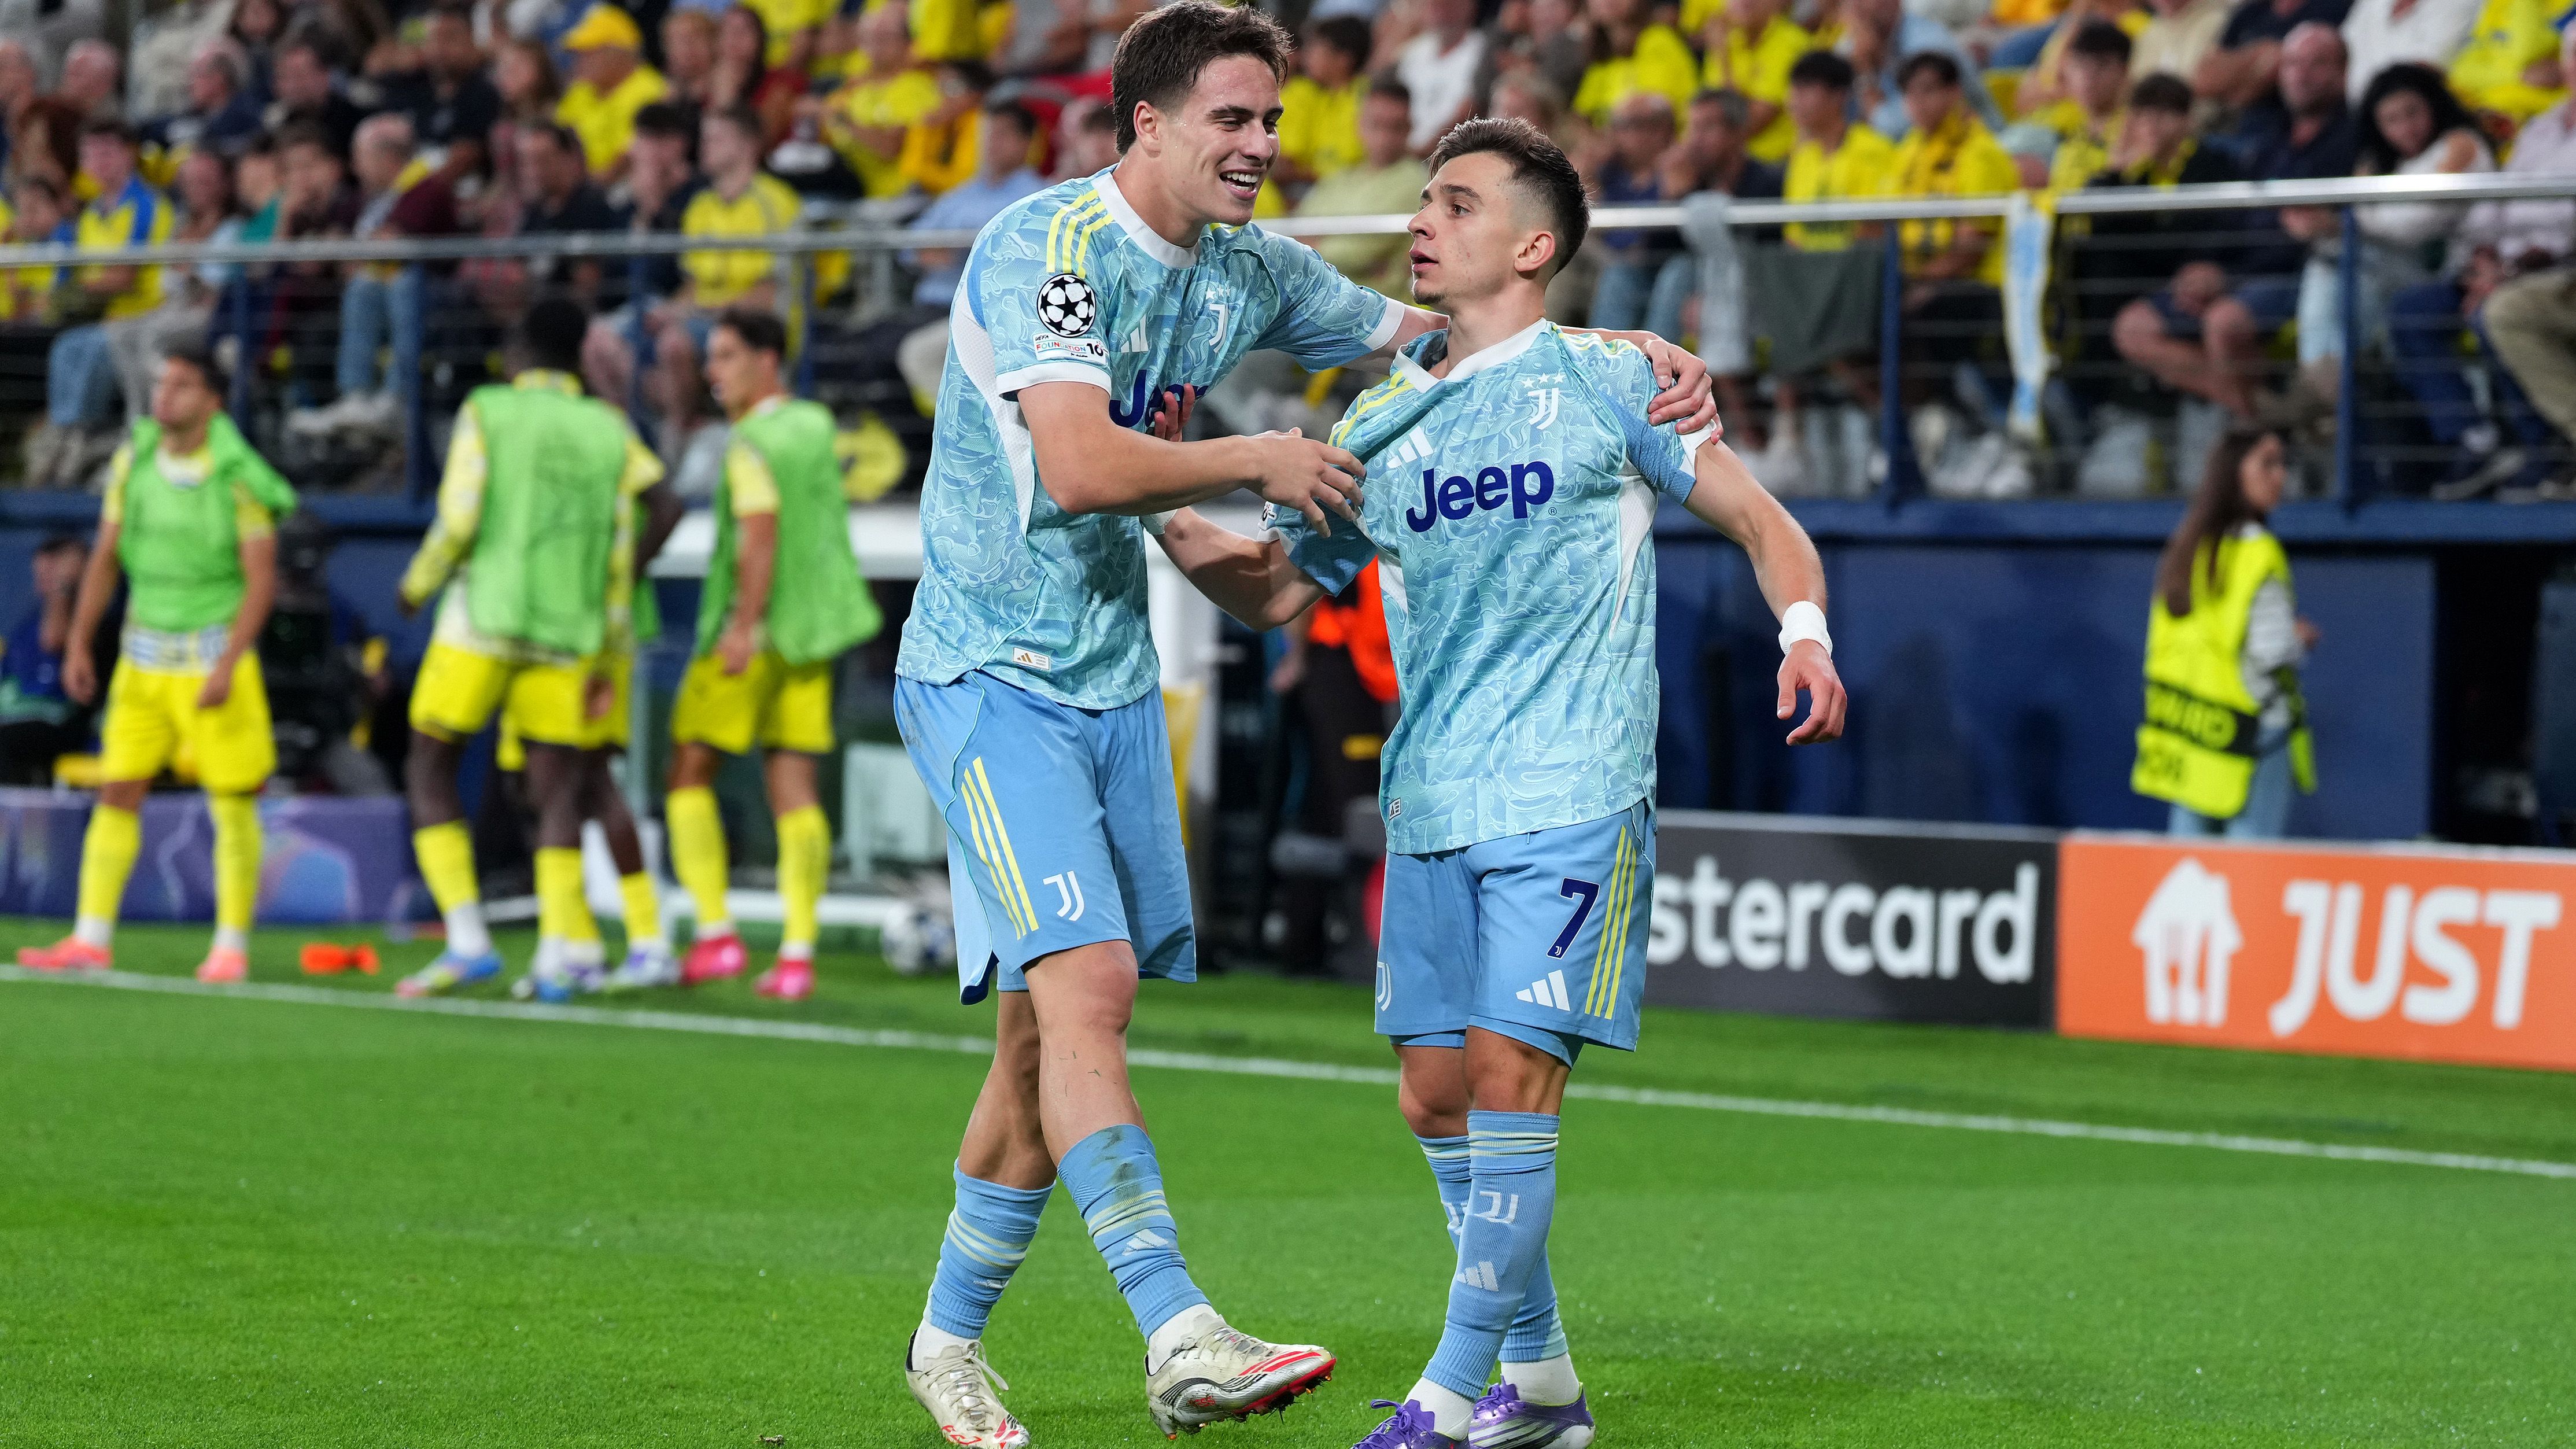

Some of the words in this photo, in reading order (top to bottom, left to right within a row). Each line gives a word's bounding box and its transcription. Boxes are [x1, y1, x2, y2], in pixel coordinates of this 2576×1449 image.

[1036, 341, 1086, 352] FOUNDATION
[1406, 461, 1554, 532] Jeep
[1547, 877, 1600, 959] 7
[2268, 879, 2563, 1038] JUST
